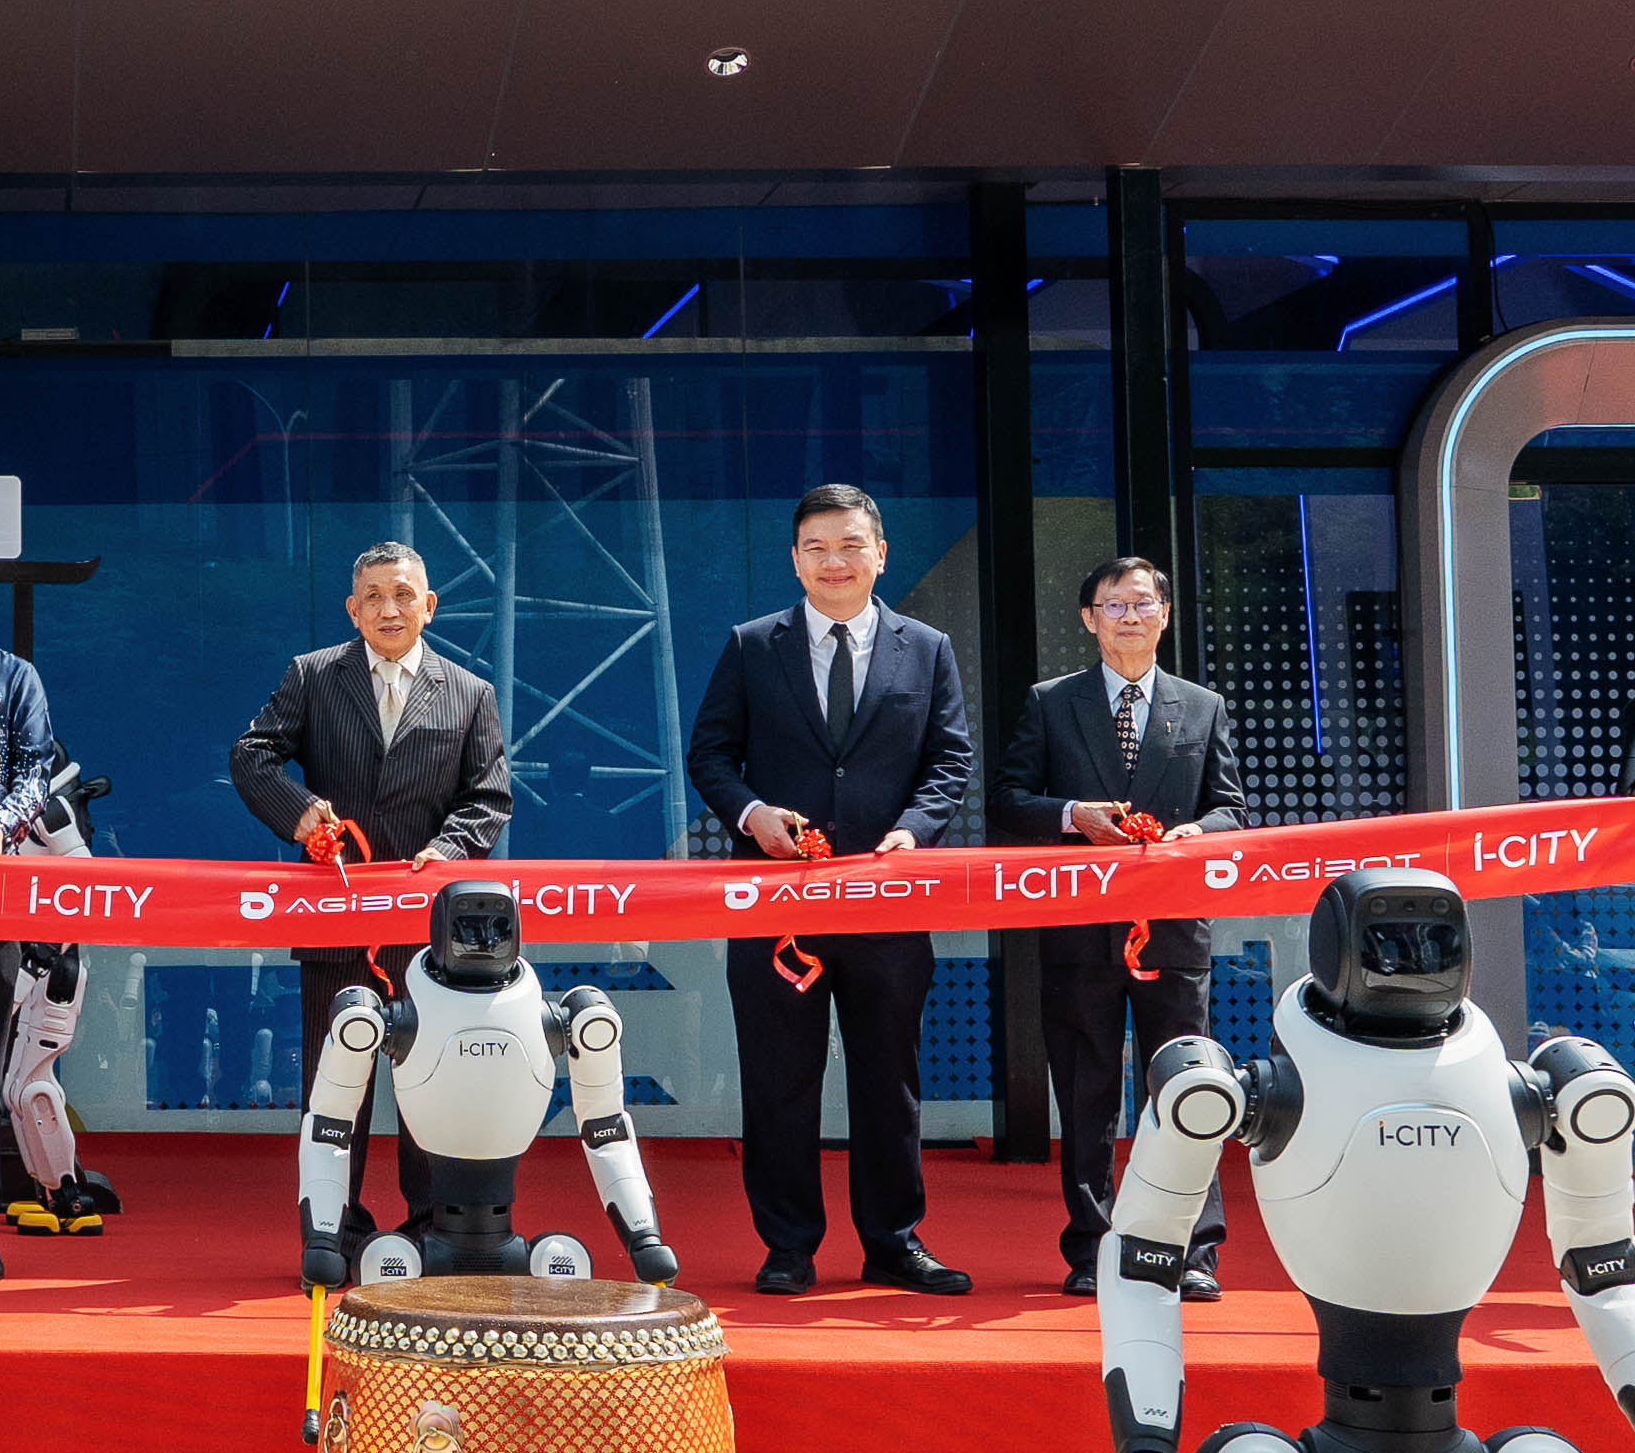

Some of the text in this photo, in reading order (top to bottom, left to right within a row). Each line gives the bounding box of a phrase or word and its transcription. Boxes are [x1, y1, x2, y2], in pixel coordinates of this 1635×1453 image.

[29, 876, 153, 918] i-CITY
[995, 862, 1119, 901] i-CITY
[1474, 827, 1598, 872] i-CITY
[460, 1040, 508, 1057] i-CITY
[1379, 1121, 1461, 1148] i-CITY
